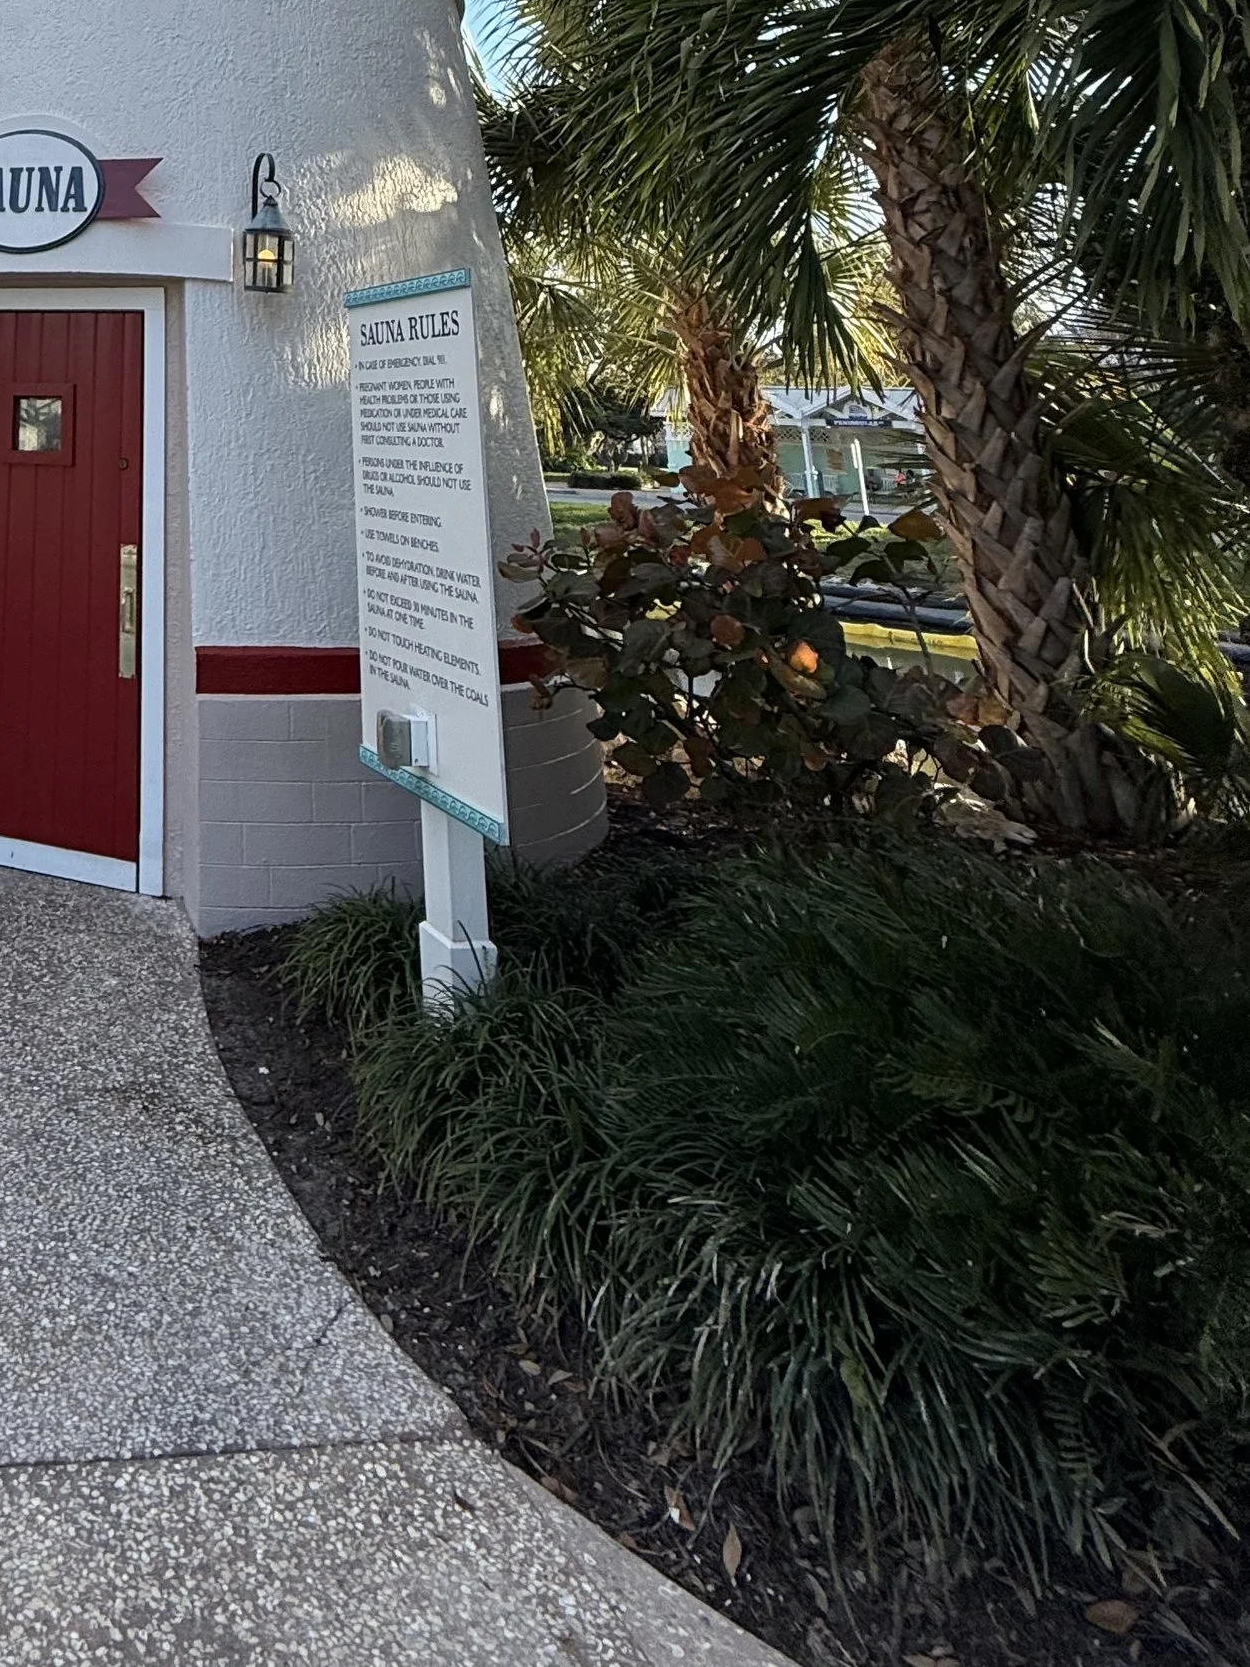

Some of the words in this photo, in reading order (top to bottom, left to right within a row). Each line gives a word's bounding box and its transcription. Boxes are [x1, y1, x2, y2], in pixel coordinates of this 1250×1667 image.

[360, 319, 405, 346] SAUNA
[408, 310, 460, 340] RULES
[359, 361, 364, 370] IN
[366, 360, 378, 370] CASE
[379, 359, 386, 369] OF
[423, 355, 436, 366] DIAL
[359, 381, 387, 392] PREGNANT
[413, 379, 435, 390] PEOPLE
[436, 378, 455, 388] WITH
[360, 395, 380, 405] HEALTH
[382, 394, 409, 404] PROBLEMS
[410, 394, 417, 404] OR
[419, 393, 440, 404] THOSE
[441, 393, 460, 404] USING
[360, 408, 392, 418] MEDICATION
[394, 408, 401, 418] OR
[403, 408, 421, 418] UNDER
[423, 408, 449, 418] MEDICAL
[451, 408, 468, 418] CARE
[361, 421, 382, 432] SHOULD
[383, 422, 395, 432] NOT
[396, 422, 406, 432] USE
[408, 422, 426, 432] SAUNA
[428, 423, 460, 434] WITHOUT
[361, 435, 376, 445] FIRST
[376, 435, 411, 446] CONSULTING
[412, 437, 417, 446] A
[362, 457, 384, 468] PERSONS
[386, 458, 404, 469] UNDER
[405, 460, 418, 470] THE
[419, 461, 453, 474] INFLUENCE
[454, 463, 463, 474] OF
[363, 470, 379, 481] DRUGS
[380, 471, 388, 481] OR
[389, 473, 415, 485] ALCOHOL
[417, 475, 441, 487] SHOULD
[443, 478, 458, 489] NOT
[459, 479, 471, 491] USE
[363, 484, 375, 494] THE
[364, 506, 387, 519] SHOWER
[389, 509, 409, 522] BEFORE
[365, 529, 375, 539] USE
[376, 530, 399, 544] TOWELS
[401, 535, 410, 546] ON
[366, 551, 374, 562] TO
[376, 554, 391, 566] AVOID
[436, 567, 455, 581] DRINK
[456, 572, 481, 588] WATER
[366, 565, 386, 579] BEFORE
[387, 571, 399, 583] AND
[401, 574, 419, 587] AFTER
[420, 578, 438, 593] USING
[440, 583, 454, 597] THE
[368, 588, 375, 599] DO
[376, 591, 389, 604] NOT
[390, 595, 412, 610] EXCEED
[421, 603, 449, 622] MINUTES
[450, 612, 457, 624] IN
[459, 614, 474, 630] THE
[368, 602, 385, 616] SAUNA
[384, 608, 393, 620] AT
[394, 611, 408, 625] ONE
[369, 626, 377, 638] DO
[378, 629, 391, 642] NOT
[391, 634, 414, 651] TOUCH
[415, 642, 443, 662] HEATING
[369, 649, 378, 661] DO
[379, 653, 391, 667] NOT
[393, 659, 408, 674] POUR
[409, 665, 431, 683] WATER
[432, 674, 449, 690] OVER
[449, 680, 465, 697] THE
[466, 687, 488, 707] COALS
[370, 664, 376, 675] IN
[377, 667, 389, 681] THE
